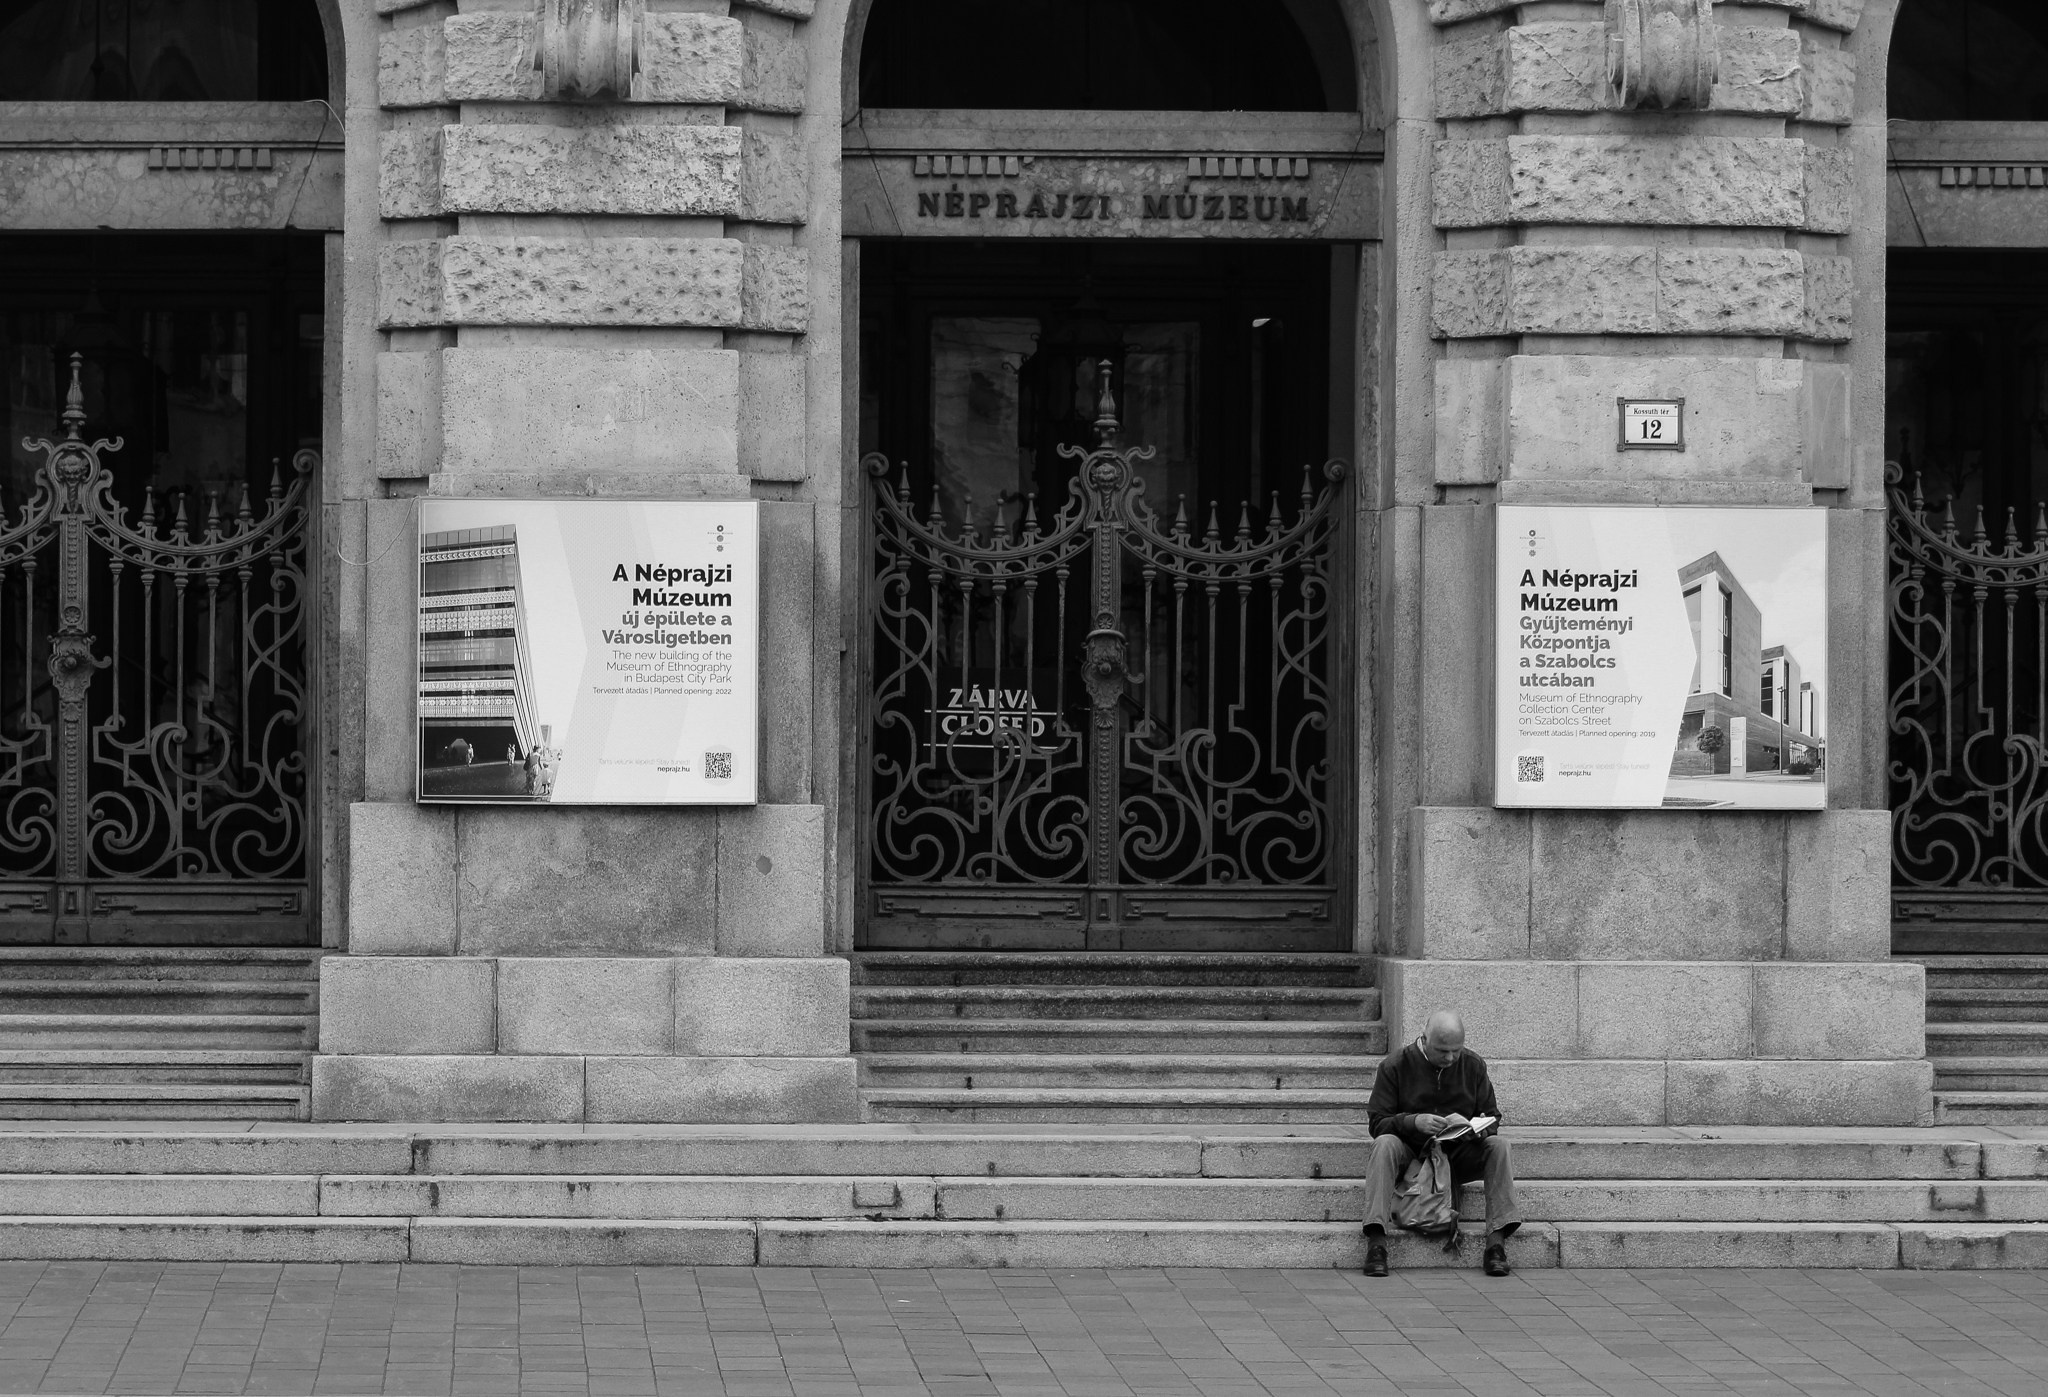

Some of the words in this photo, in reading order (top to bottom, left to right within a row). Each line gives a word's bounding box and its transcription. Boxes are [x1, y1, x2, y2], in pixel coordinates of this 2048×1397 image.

[917, 184, 1110, 219] NÉPRAJZI
[1142, 185, 1309, 222] MÚZEUM
[1641, 419, 1662, 439] 12
[612, 563, 629, 582] A
[635, 563, 732, 587] Néprajzi
[1519, 568, 1536, 587] A
[1542, 569, 1638, 592] Néprajzi
[632, 587, 732, 607] Múzeum
[1520, 592, 1618, 612] Múzeum
[622, 610, 640, 629] új
[643, 610, 717, 629] épülete
[720, 614, 732, 626] a
[1519, 615, 1633, 635] Gyűjteményi
[602, 629, 732, 648] Városligetben
[1519, 634, 1611, 653] Központja
[612, 650, 632, 660] The
[634, 652, 656, 660] new
[659, 650, 699, 662] building
[702, 650, 713, 660] of
[715, 650, 732, 660] the
[1519, 657, 1531, 669] a
[1535, 654, 1616, 669] Szabolcs
[606, 661, 651, 672] Museum
[654, 661, 665, 672] of
[667, 661, 732, 674] Ethnography
[624, 673, 633, 683] in
[635, 673, 684, 685] Budapest
[687, 673, 707, 686] City
[709, 674, 732, 684] Park
[1519, 673, 1595, 687] utcában
[593, 686, 624, 695] Tervezett
[653, 687, 683, 695] Planned
[948, 684, 1038, 709] ZÁRVA
[1519, 693, 1563, 703] Museum
[1566, 693, 1577, 703] of
[1579, 693, 1643, 705] Ethnography
[1518, 704, 1568, 714] Collection
[1571, 704, 1605, 714] Center
[1518, 716, 1532, 726] on
[1534, 716, 1580, 726] Szabolcs
[1581, 716, 1612, 726] Street
[1518, 729, 1549, 737] Tervezett
[1578, 729, 1607, 737] Planned
